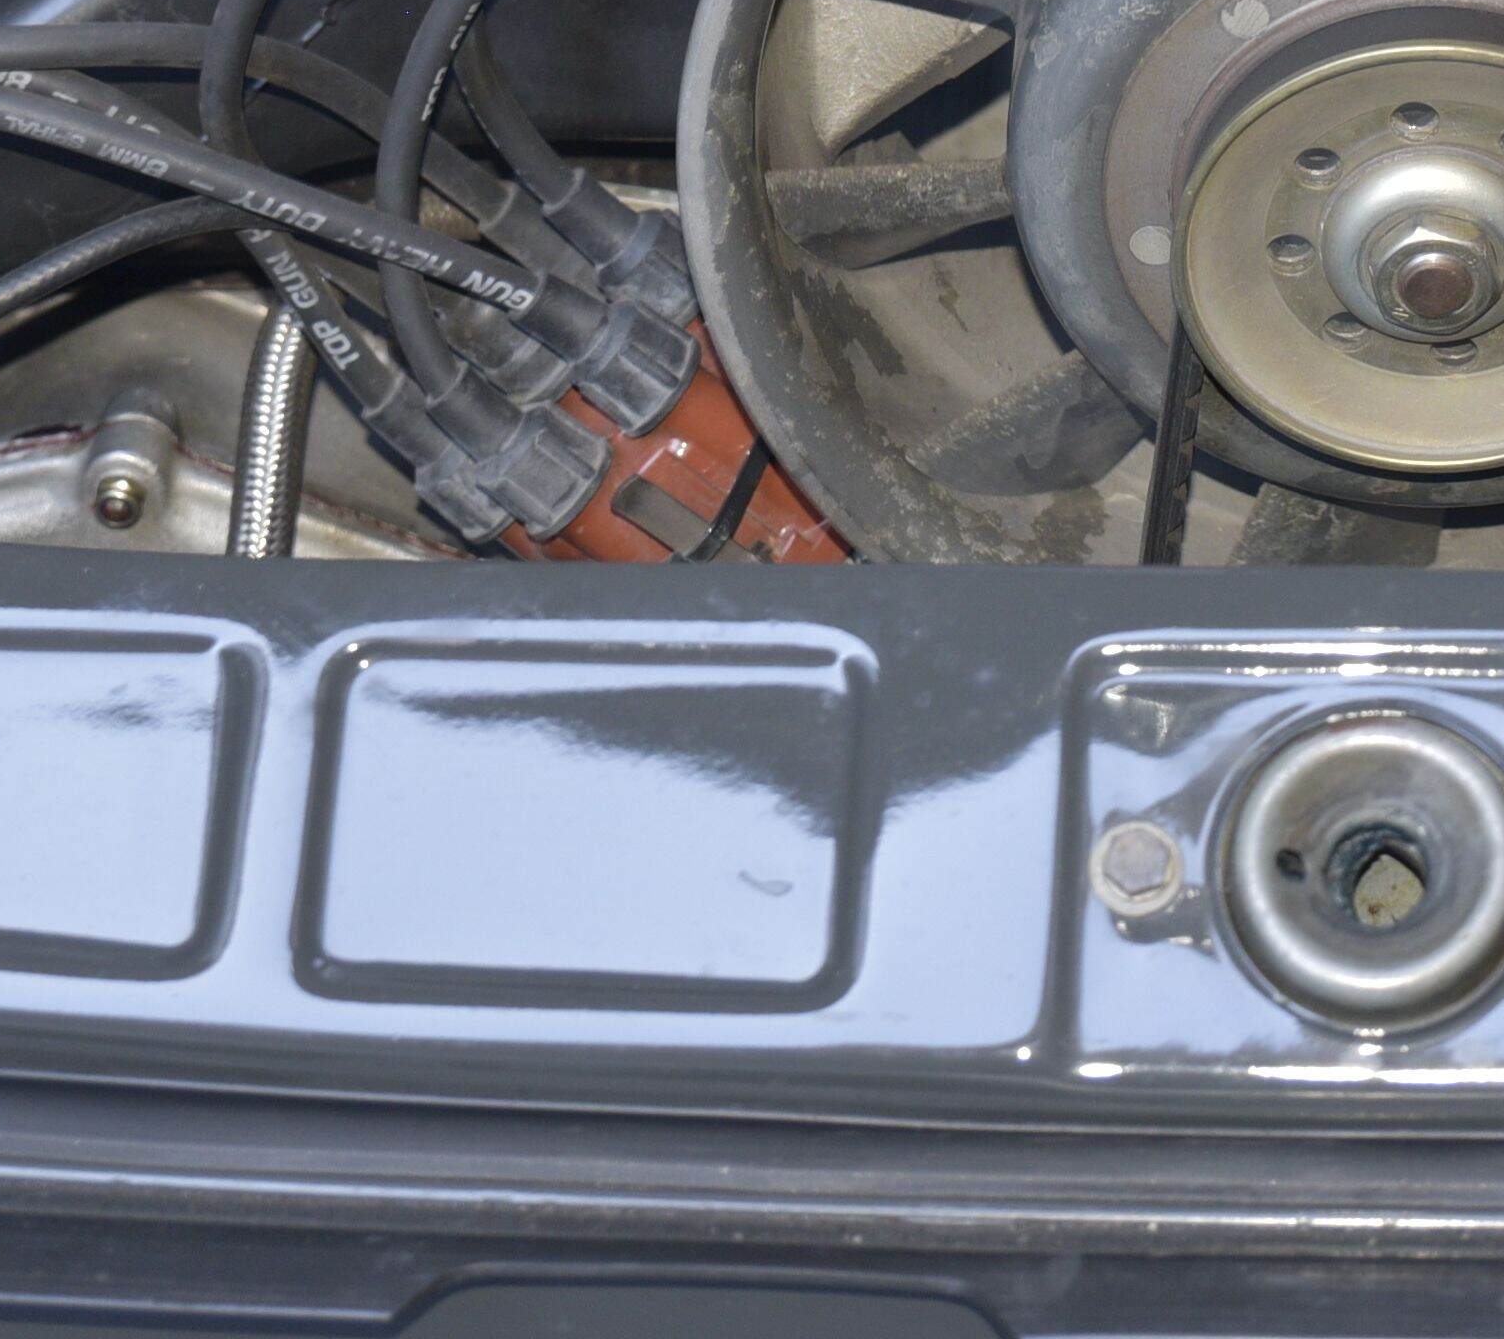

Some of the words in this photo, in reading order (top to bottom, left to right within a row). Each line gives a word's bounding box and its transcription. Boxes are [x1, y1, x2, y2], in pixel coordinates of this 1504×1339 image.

[98, 144, 170, 178] 8MM
[233, 190, 328, 232] DUTY
[264, 249, 321, 310] GUN
[459, 269, 536, 311] GUN
[310, 320, 361, 371] TOP
